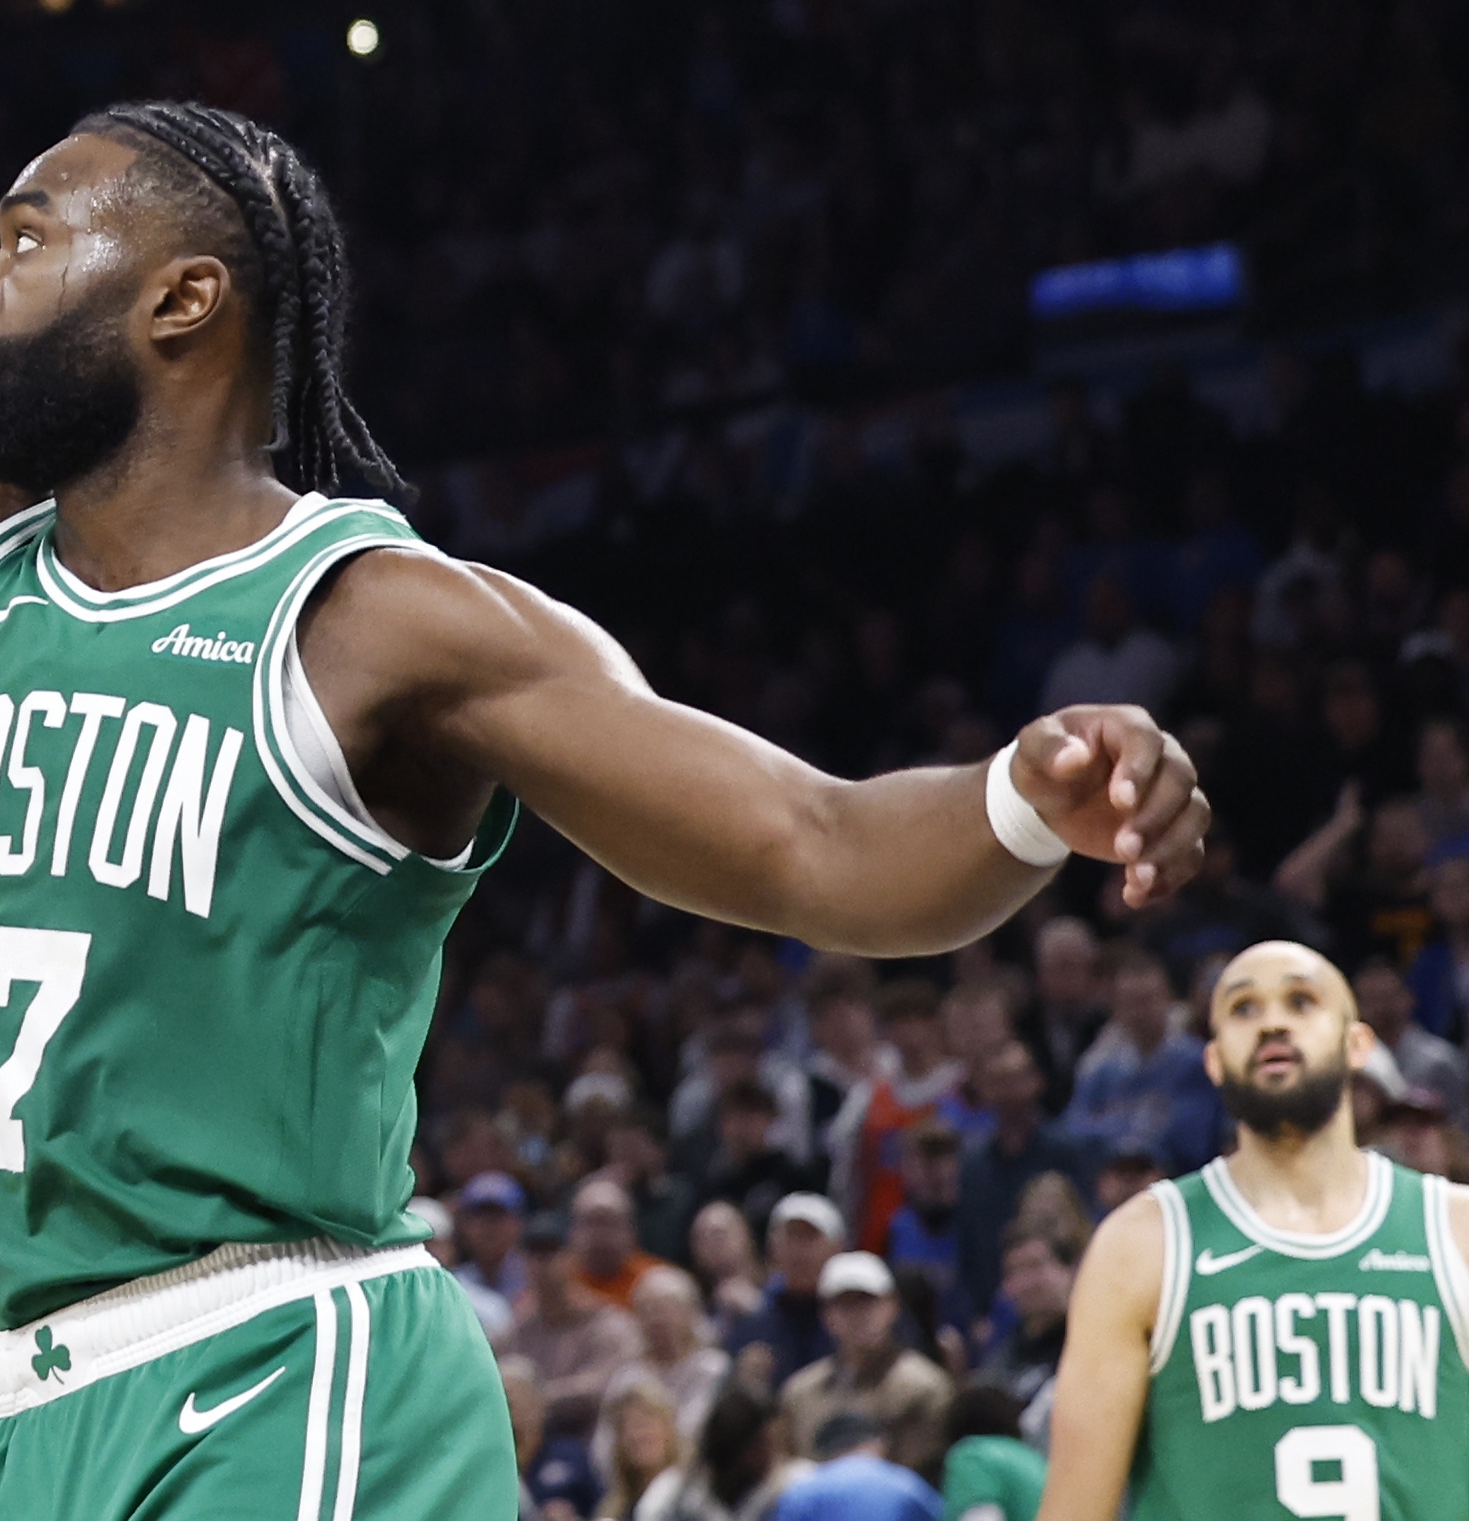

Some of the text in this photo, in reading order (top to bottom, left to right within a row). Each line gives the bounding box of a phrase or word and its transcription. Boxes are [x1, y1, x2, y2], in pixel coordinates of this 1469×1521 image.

[152, 624, 256, 664] Amica
[1190, 1292, 1440, 1423] BOSTON
[1274, 1424, 1381, 1521] 9
